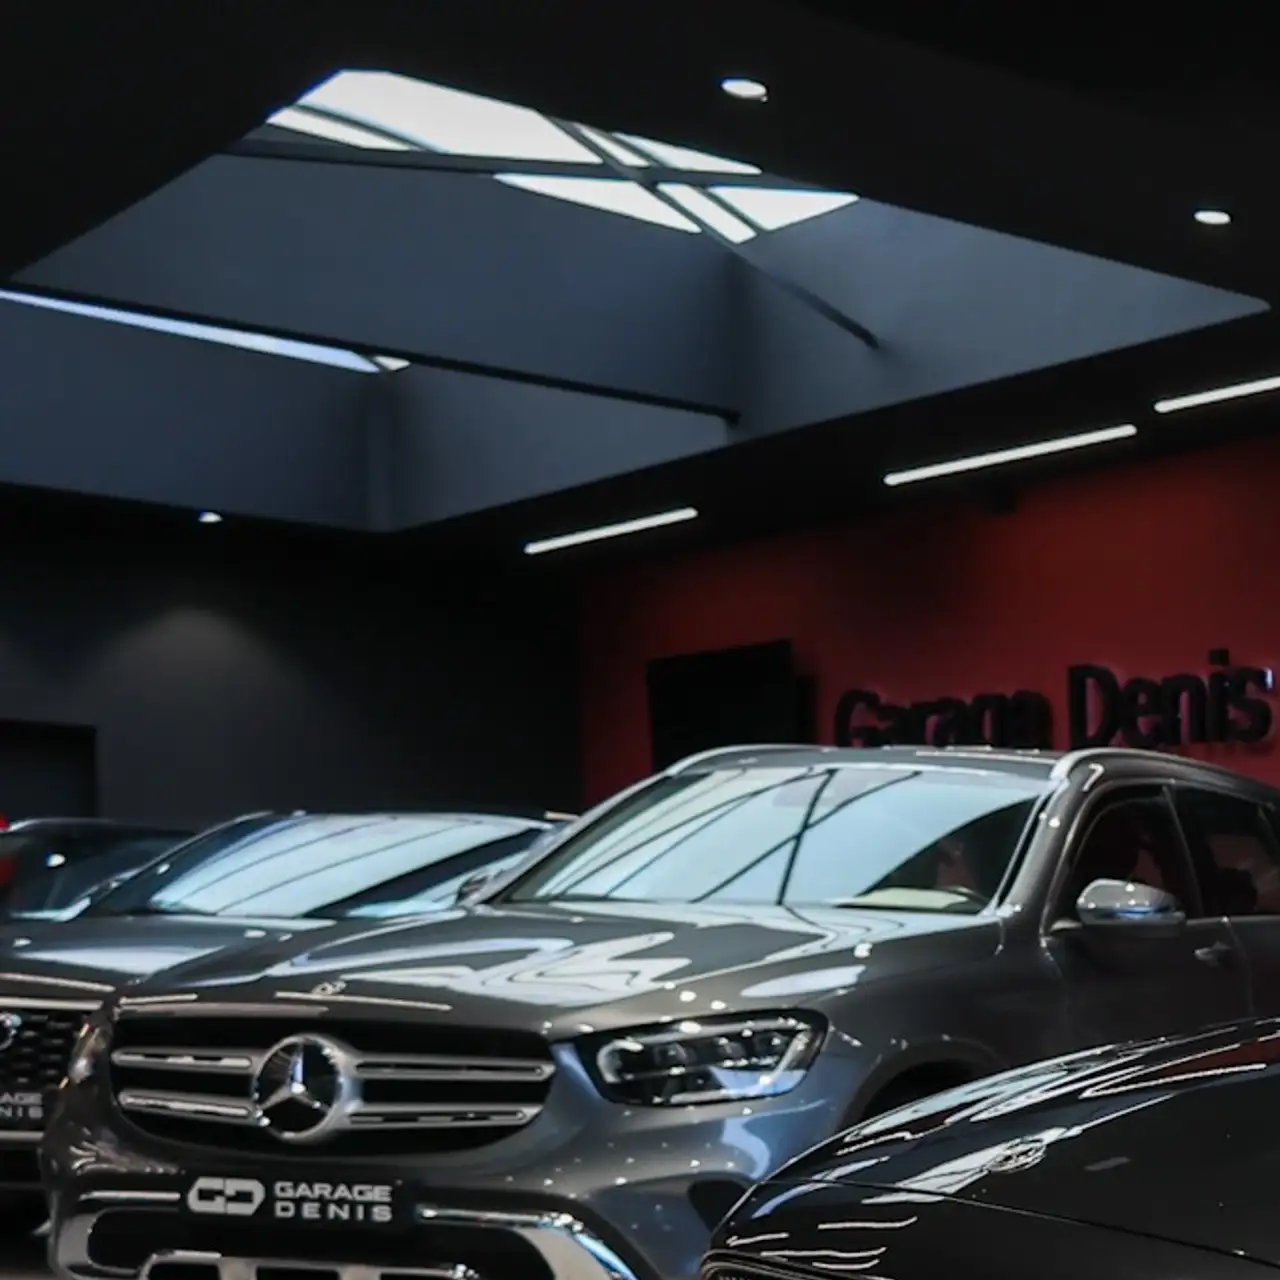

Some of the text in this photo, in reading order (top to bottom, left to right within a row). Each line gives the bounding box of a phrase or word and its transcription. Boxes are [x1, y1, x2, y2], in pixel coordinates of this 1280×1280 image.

[1067, 647, 1276, 750] Denis
[274, 1181, 393, 1201] GARAGE
[274, 1201, 393, 1222] DENIS
